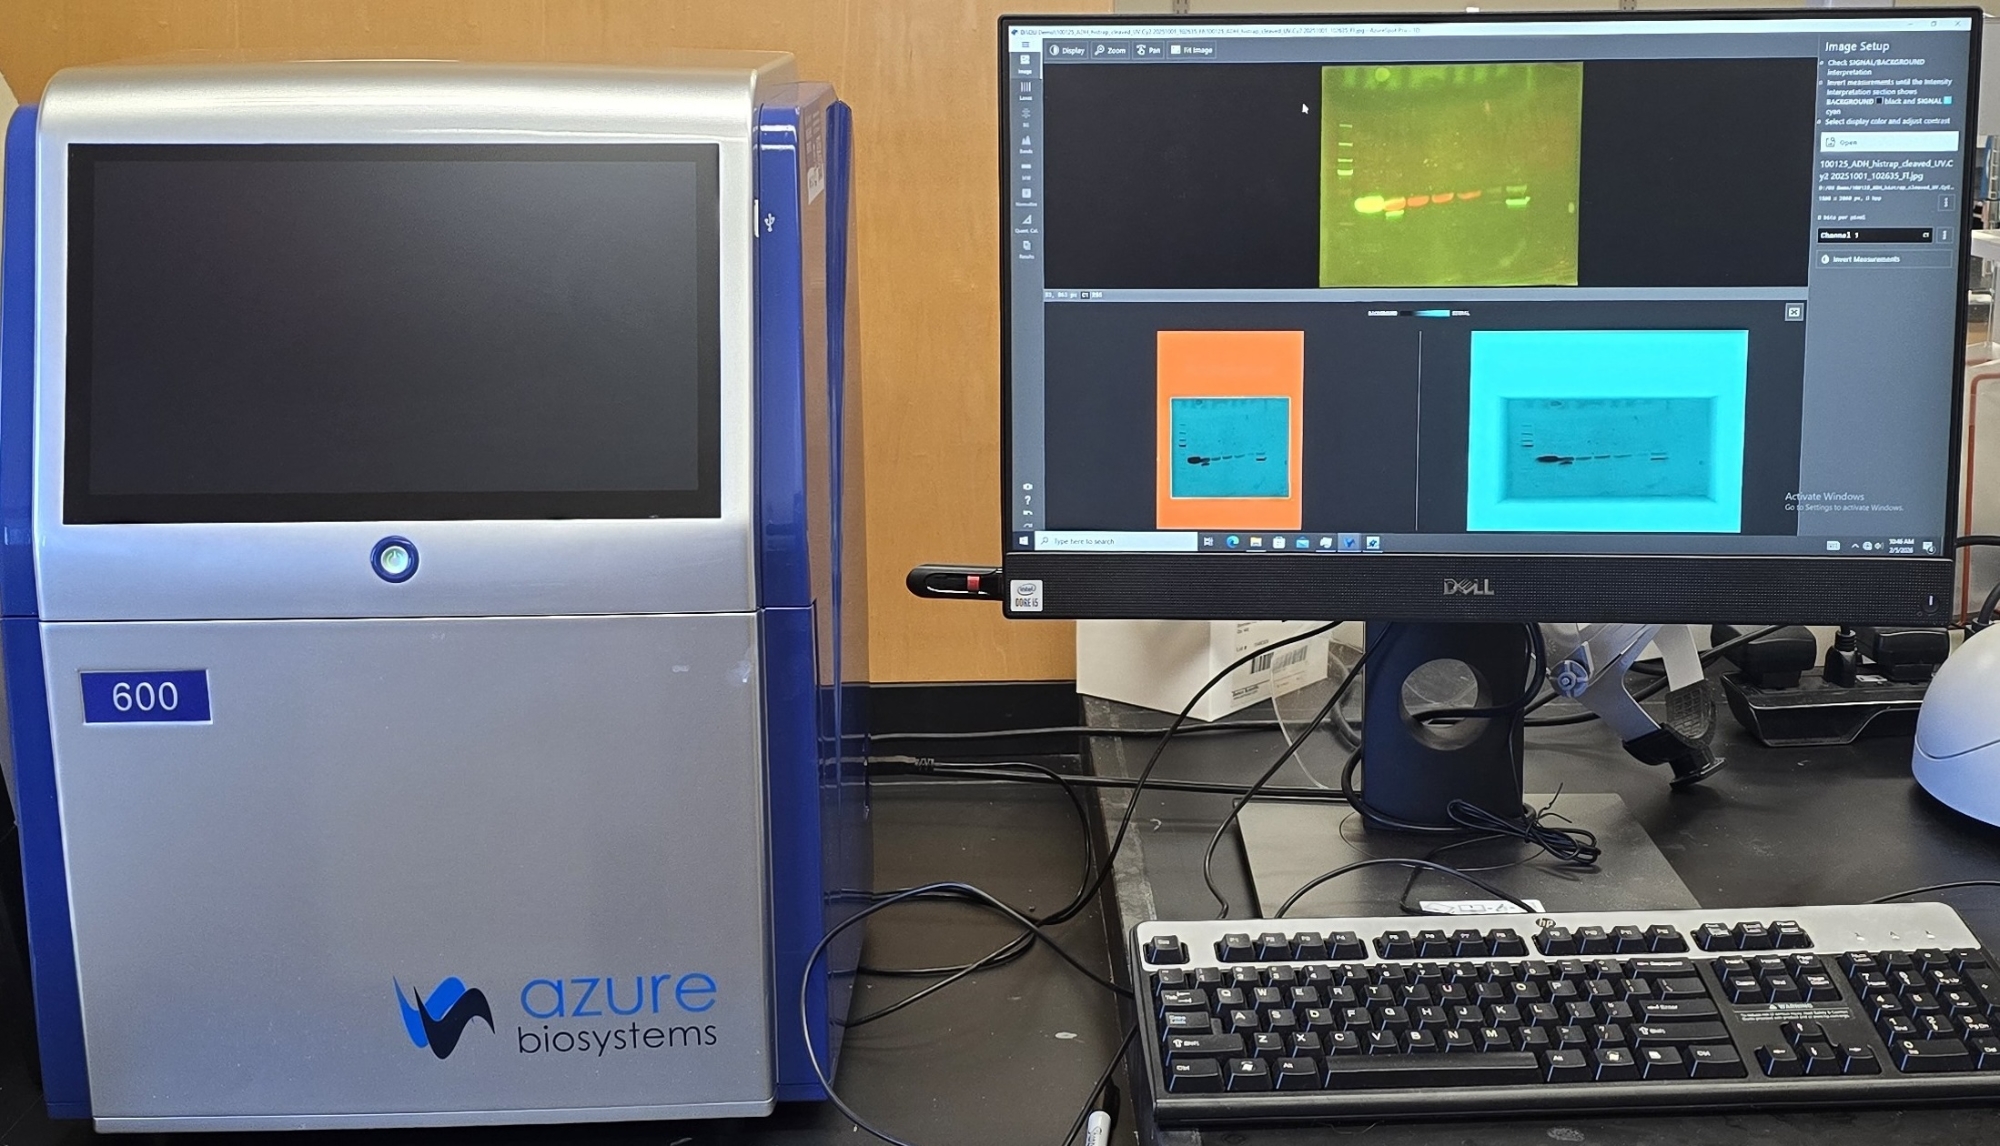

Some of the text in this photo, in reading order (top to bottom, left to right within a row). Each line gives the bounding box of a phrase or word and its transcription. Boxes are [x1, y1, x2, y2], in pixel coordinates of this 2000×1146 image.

[1062, 47, 1085, 56] Display
[1825, 41, 1890, 54] Image Setup
[1849, 59, 1925, 67] SIGNAL/BACKGROUND
[1846, 117, 1869, 126] display
[1870, 117, 1887, 125] color
[1888, 117, 1901, 125] and
[1902, 117, 1922, 126] adjust
[1819, 172, 1829, 182] y2
[1785, 492, 1865, 501] Activate Windows
[1806, 503, 1833, 512] Settings
[1843, 503, 1870, 511] activate
[1871, 503, 1904, 511] Windows.
[1054, 538, 1068, 546] Type
[1443, 578, 1495, 596] DELL
[1015, 598, 1031, 607] CORE
[112, 682, 178, 711] 600
[1369, 986, 1378, 994] T
[1405, 985, 1414, 993] Y
[1551, 982, 1561, 990] P
[520, 972, 717, 1019] azure
[1295, 988, 1304, 996] E
[1333, 987, 1343, 995] R
[1347, 1009, 1356, 1017] F
[1384, 1007, 1395, 1015] G
[1421, 1007, 1432, 1016] H
[1459, 1007, 1467, 1015] J
[1495, 1005, 1507, 1014] K
[1533, 1005, 1543, 1013] L
[1235, 1011, 1246, 1020] A
[1271, 1010, 1281, 1018] S
[1309, 1010, 1319, 1018] D
[1296, 1033, 1306, 1042] X
[1334, 1033, 1344, 1041] C
[1371, 1032, 1381, 1040] V
[1410, 1031, 1421, 1040] B
[1447, 1030, 1459, 1039] N
[1485, 1029, 1498, 1038] M
[517, 1022, 717, 1057] biosystems
[1258, 1035, 1268, 1043] Z
